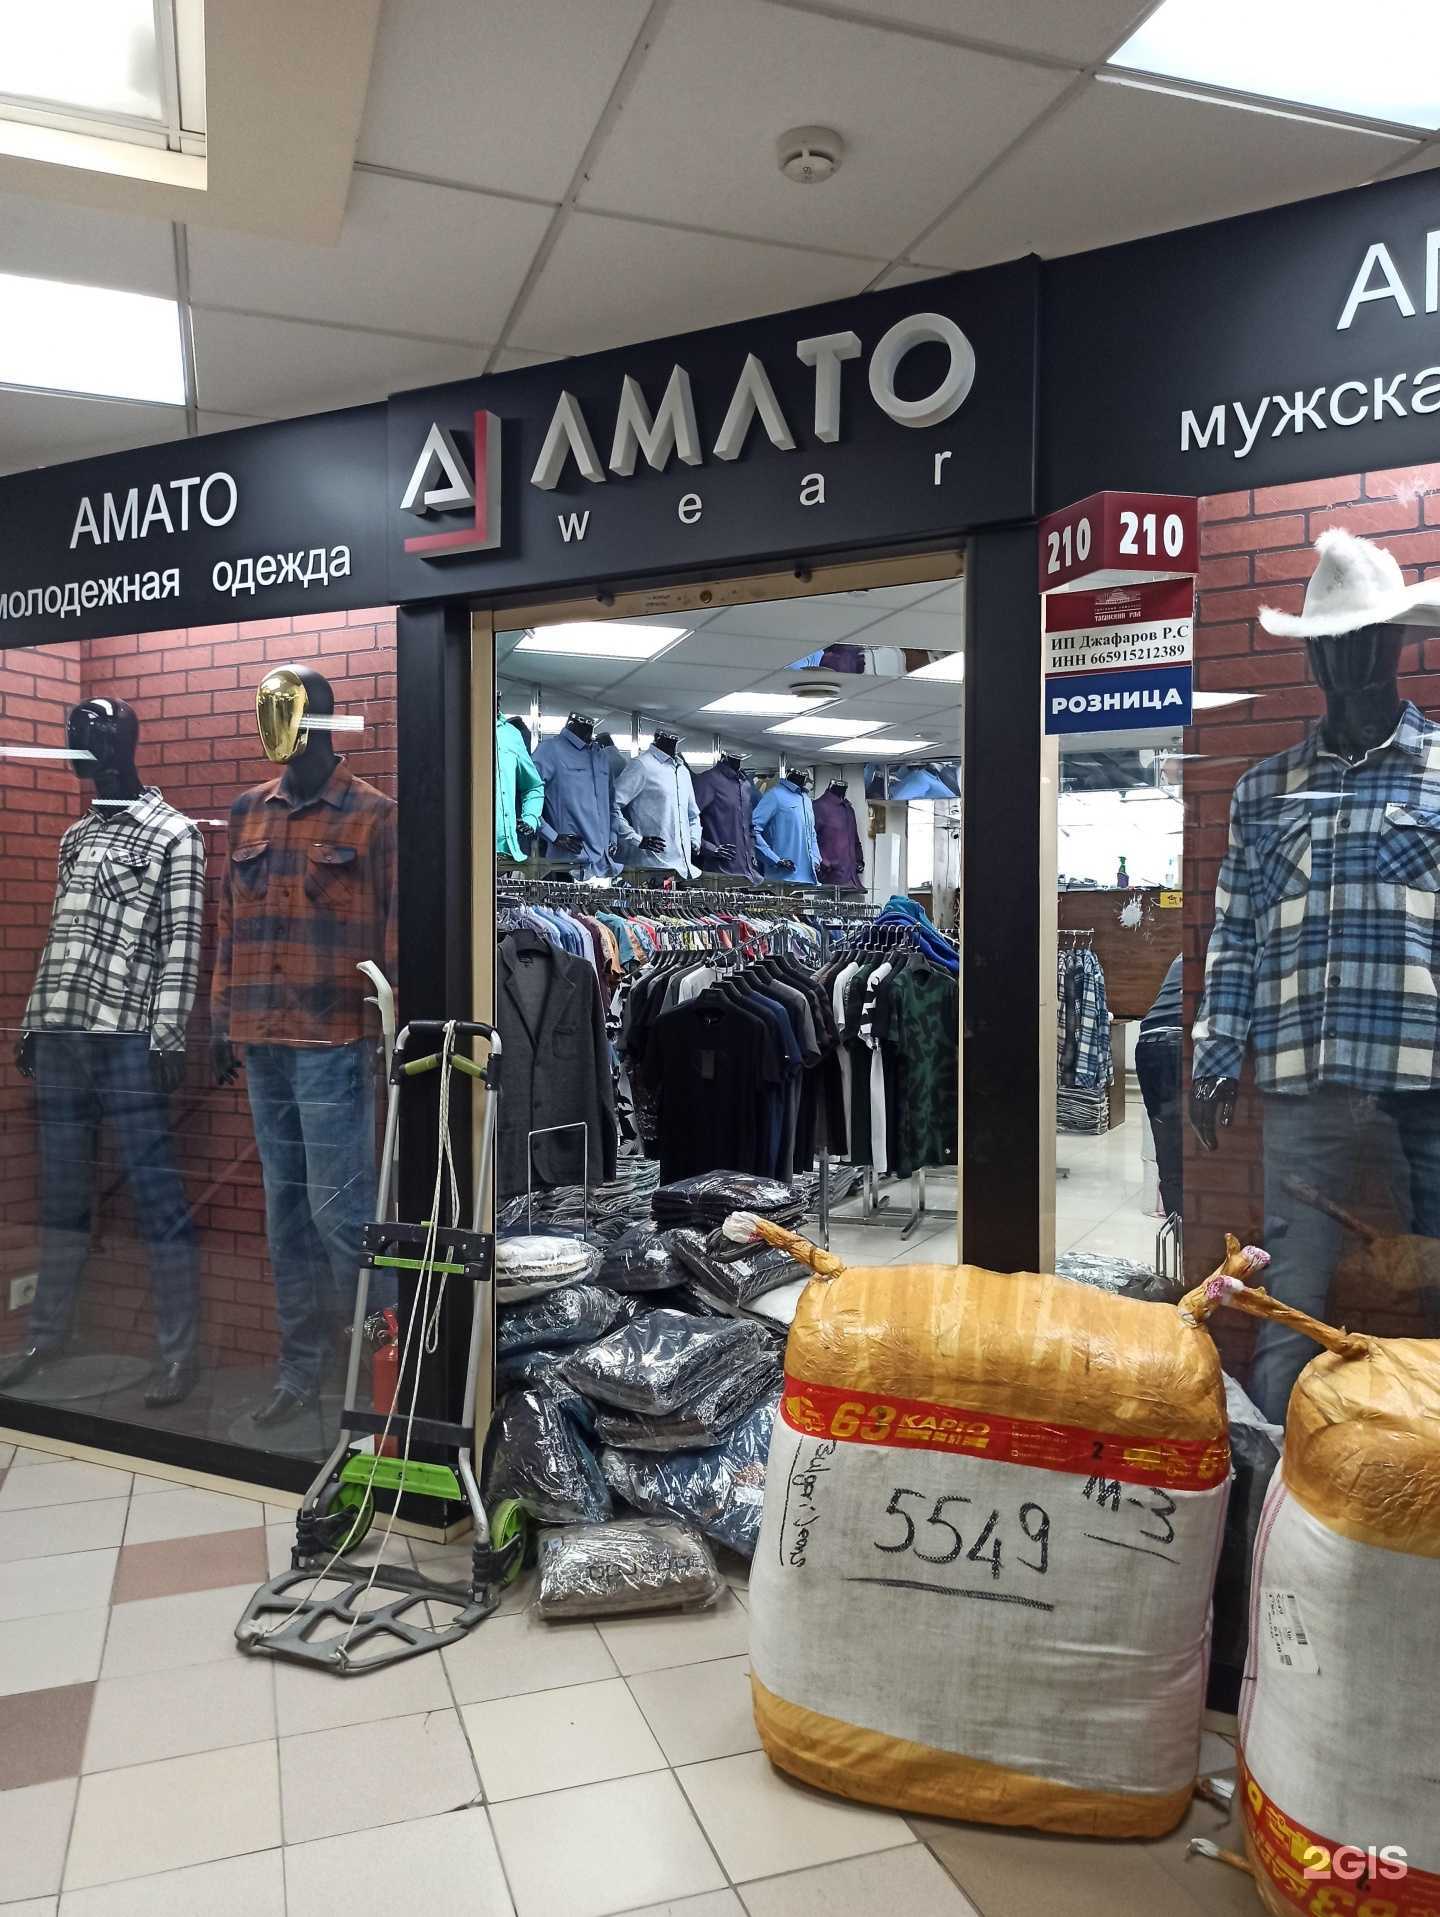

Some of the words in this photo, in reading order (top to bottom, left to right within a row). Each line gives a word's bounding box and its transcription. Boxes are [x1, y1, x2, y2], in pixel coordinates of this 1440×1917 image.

[1336, 230, 1440, 331] А
[69, 471, 238, 549] АМАТО
[1119, 511, 1184, 557] 210
[212, 544, 351, 594] одежда
[1047, 517, 1091, 575] 210
[1051, 637, 1075, 650] ИП
[1079, 631, 1158, 649] Джафаров
[1052, 654, 1086, 668] ИНН
[1090, 644, 1185, 664] 665915212389
[1052, 687, 1183, 715] РОЗНИЦА
[830, 1401, 896, 1442] 63
[873, 1488, 1050, 1579] 5549
